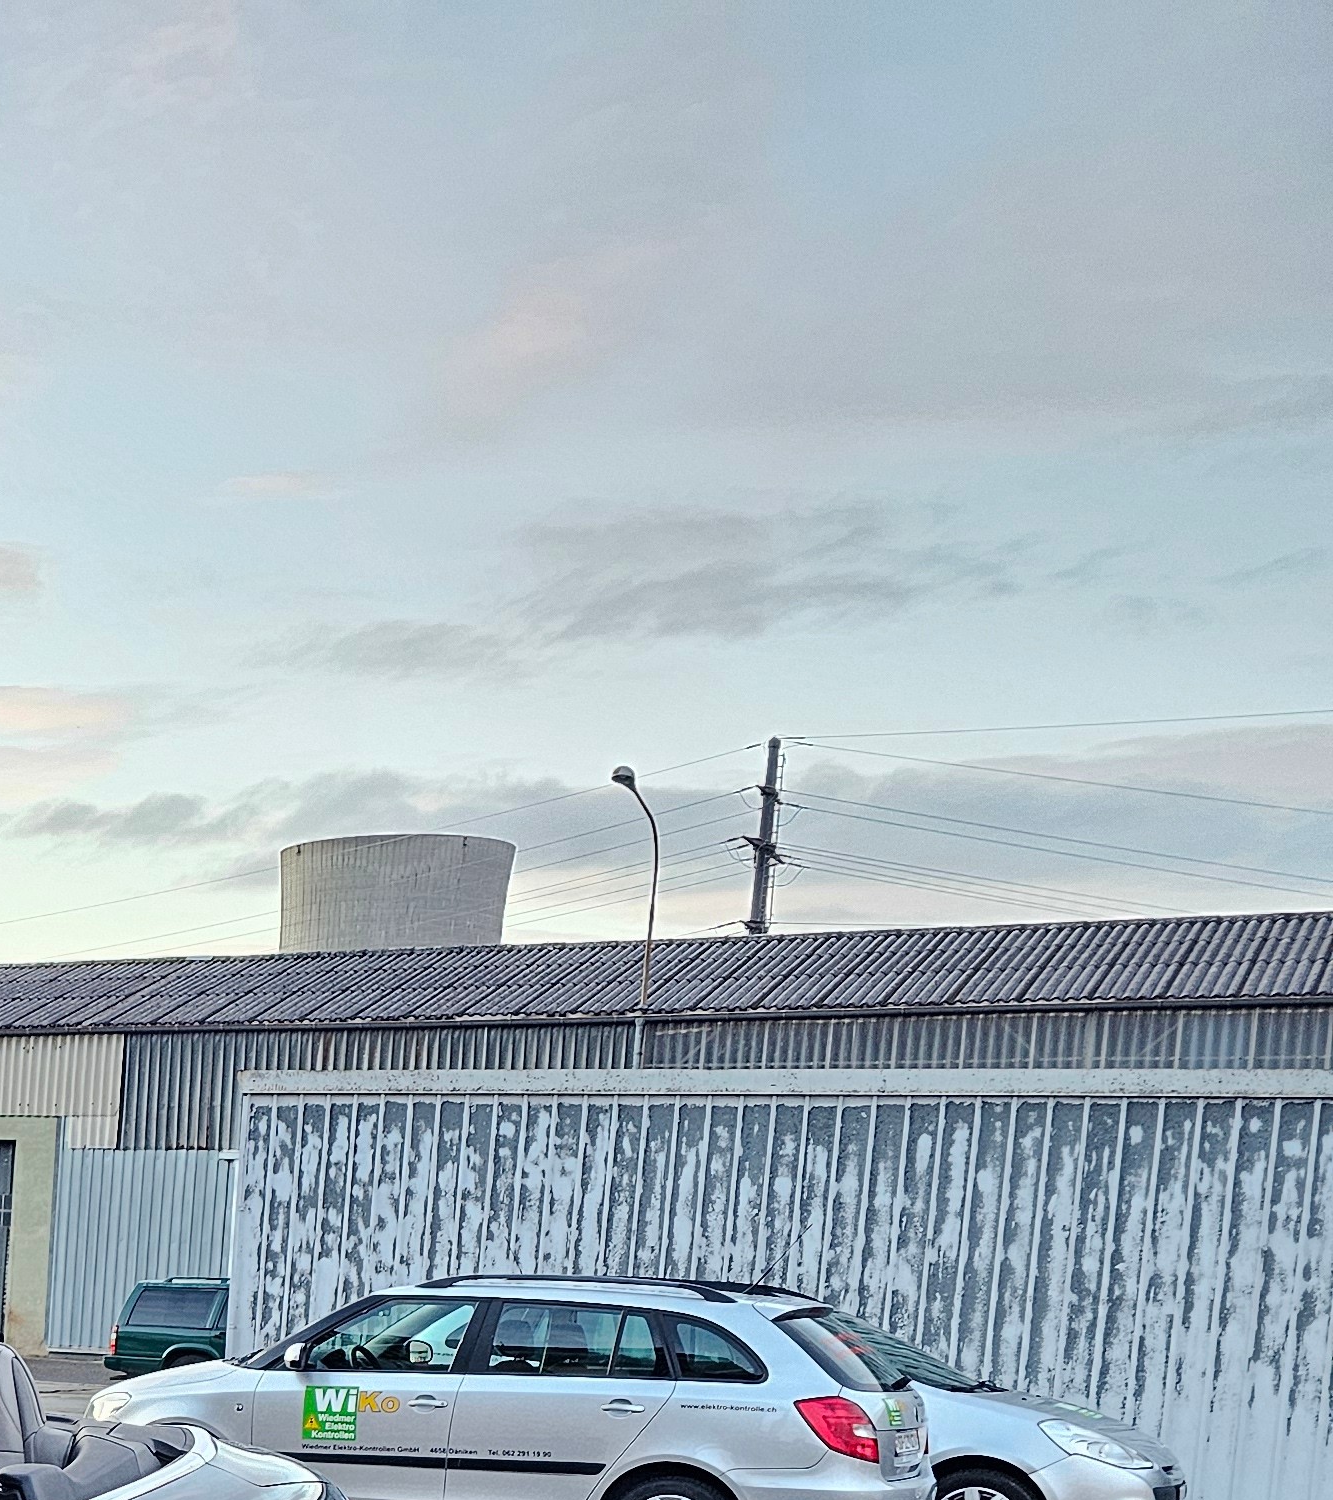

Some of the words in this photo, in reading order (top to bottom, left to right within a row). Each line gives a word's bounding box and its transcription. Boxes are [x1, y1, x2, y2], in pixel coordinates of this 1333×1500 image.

[315, 1388, 400, 1413] WiKo
[680, 1403, 777, 1413] www.elektro-kontrolle.ch
[317, 1414, 356, 1422] Wiedmer
[325, 1422, 355, 1431] Elektro
[311, 1430, 355, 1440] Kontrollen
